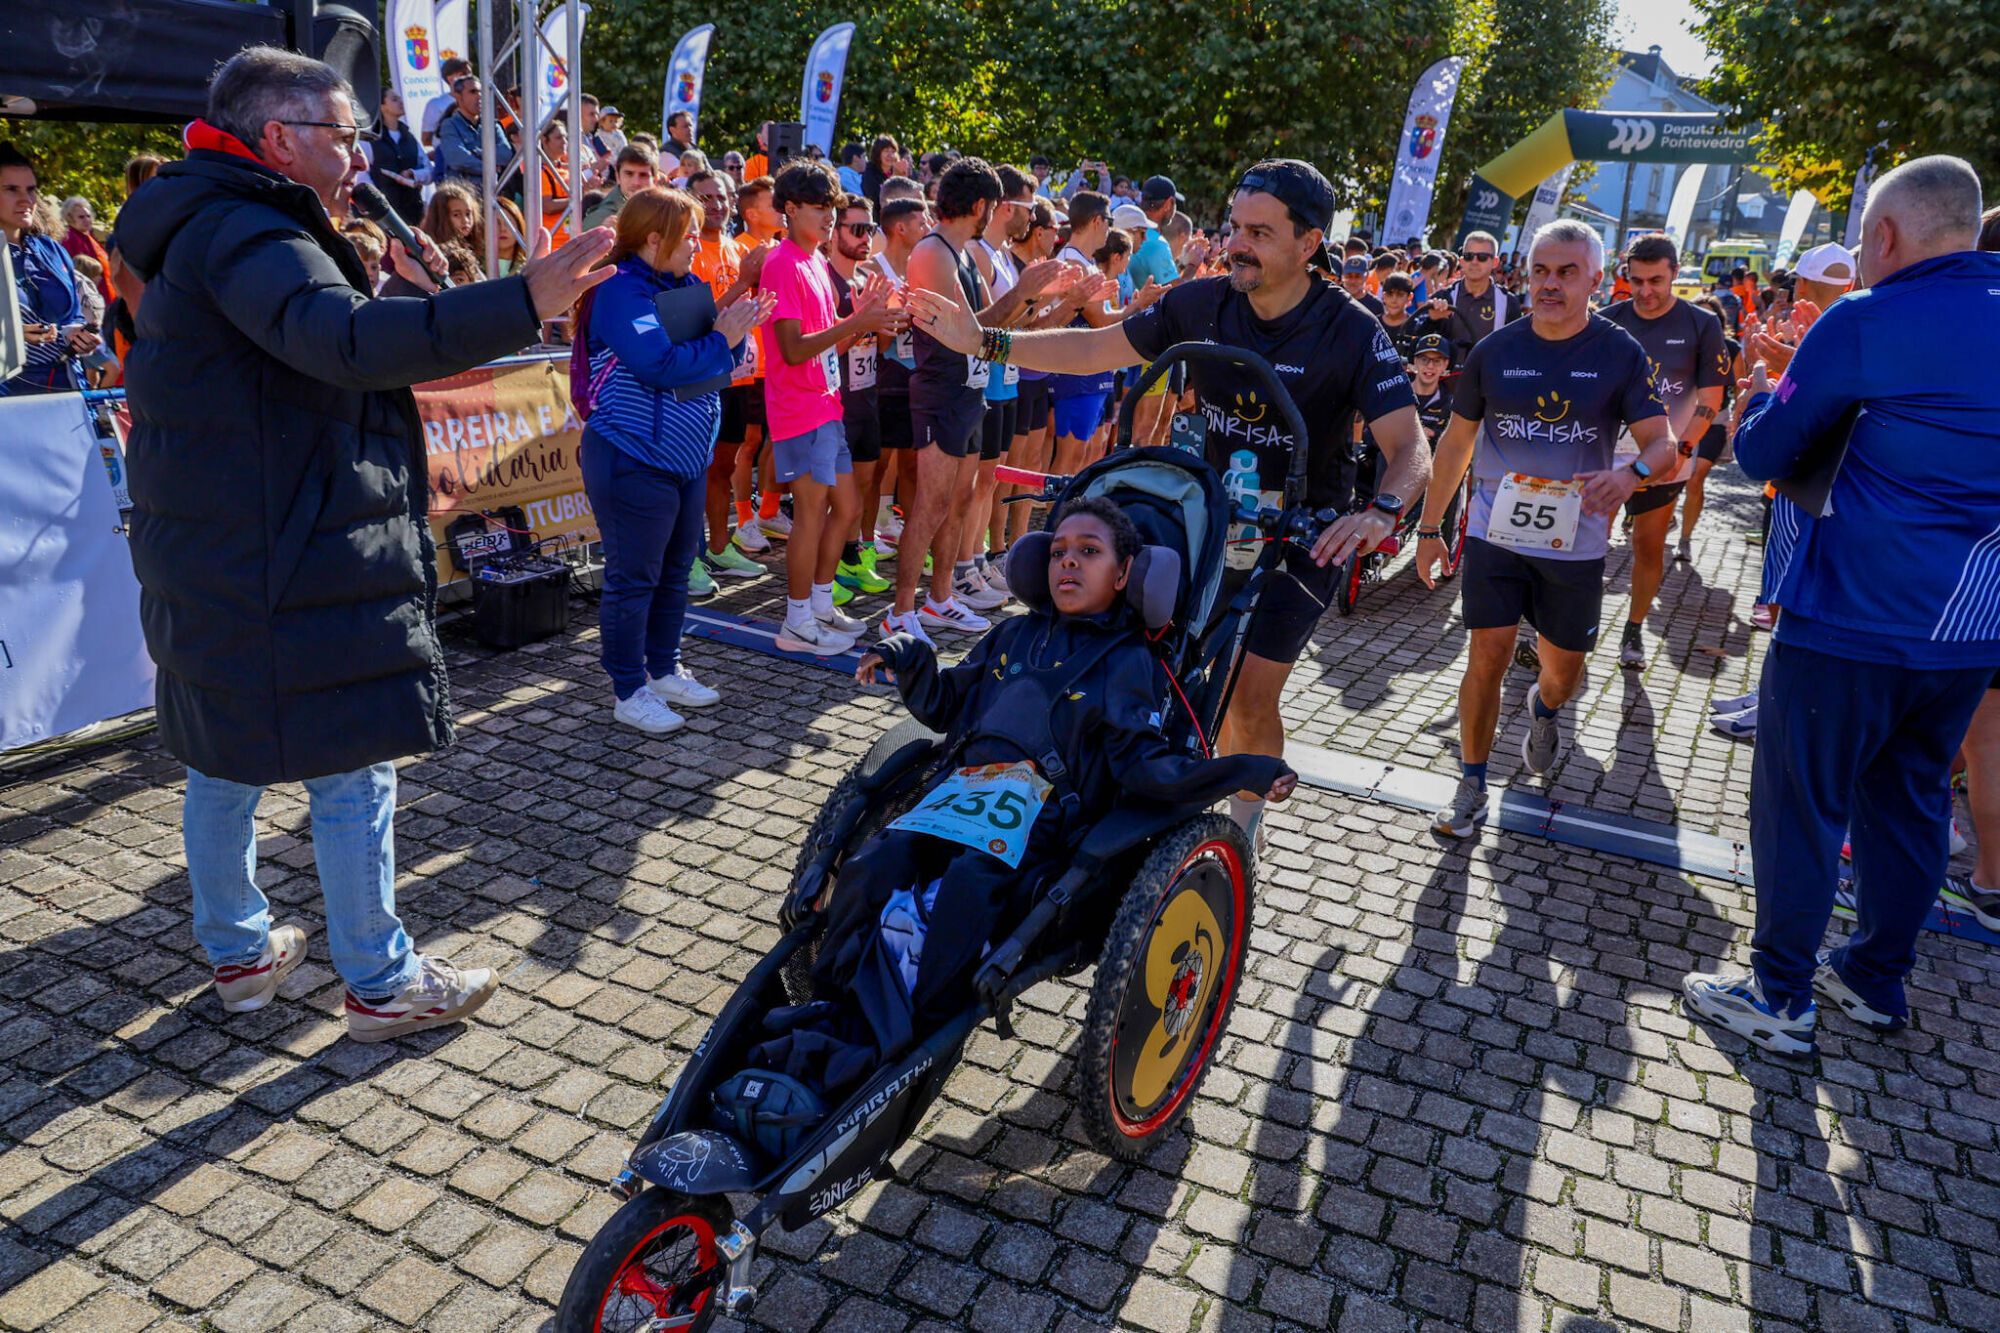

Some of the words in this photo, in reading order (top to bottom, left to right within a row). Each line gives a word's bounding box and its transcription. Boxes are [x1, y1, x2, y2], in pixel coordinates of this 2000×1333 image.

[1660, 136, 1745, 149] Pontevedra
[426, 410, 534, 456] RREIRA
[1497, 417, 1598, 444] SONRISAS
[1509, 501, 1558, 530] 55
[921, 789, 1027, 830] 435
[836, 1056, 933, 1136] MARATH
